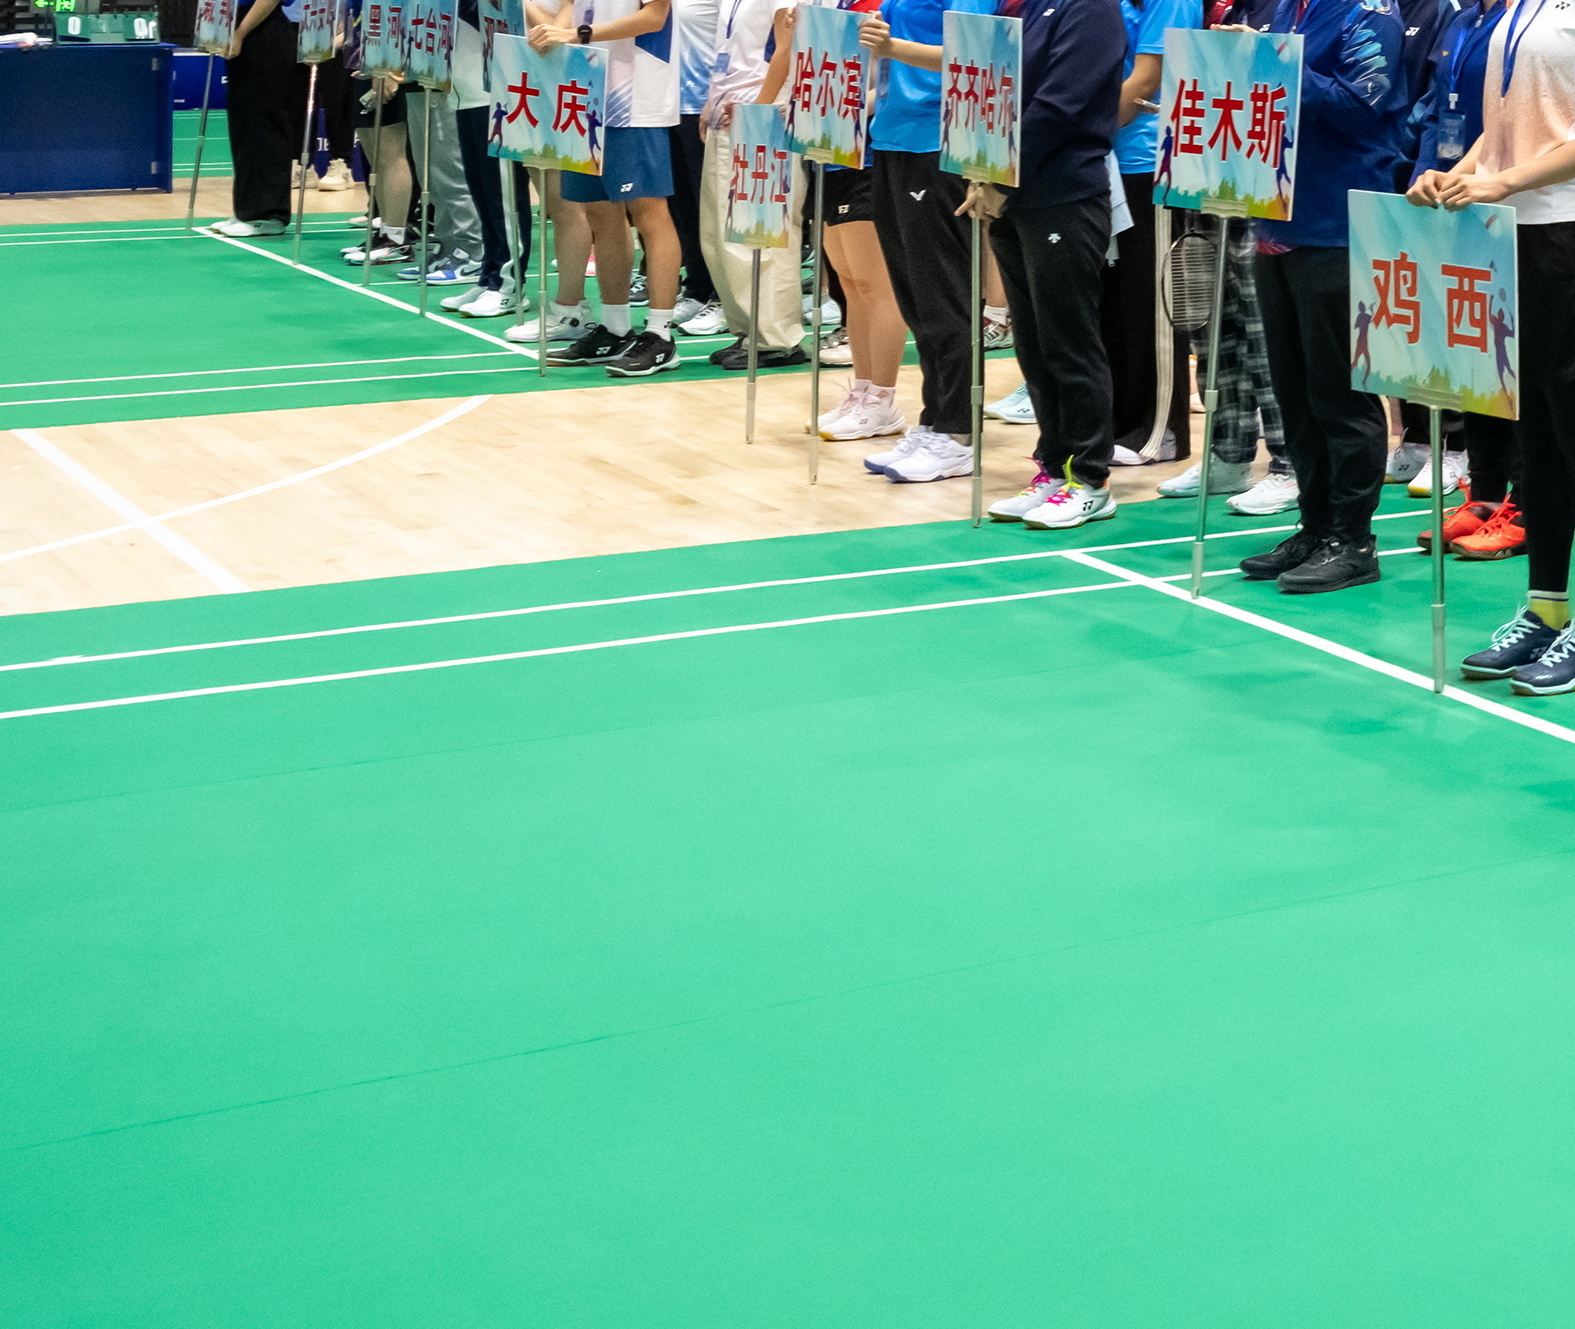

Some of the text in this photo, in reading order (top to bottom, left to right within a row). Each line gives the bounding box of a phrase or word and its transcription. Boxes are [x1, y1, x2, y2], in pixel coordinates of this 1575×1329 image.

[367, 5, 402, 49] 黑河
[411, 4, 453, 61] 七台河
[505, 72, 589, 138] 大庆
[793, 46, 862, 121] 哈尔滨
[946, 56, 1014, 138] 齐齐哈尔
[1169, 77, 1289, 171] 佳木斯
[730, 143, 788, 205] 牡丹江
[1372, 251, 1491, 354] 鸡西
